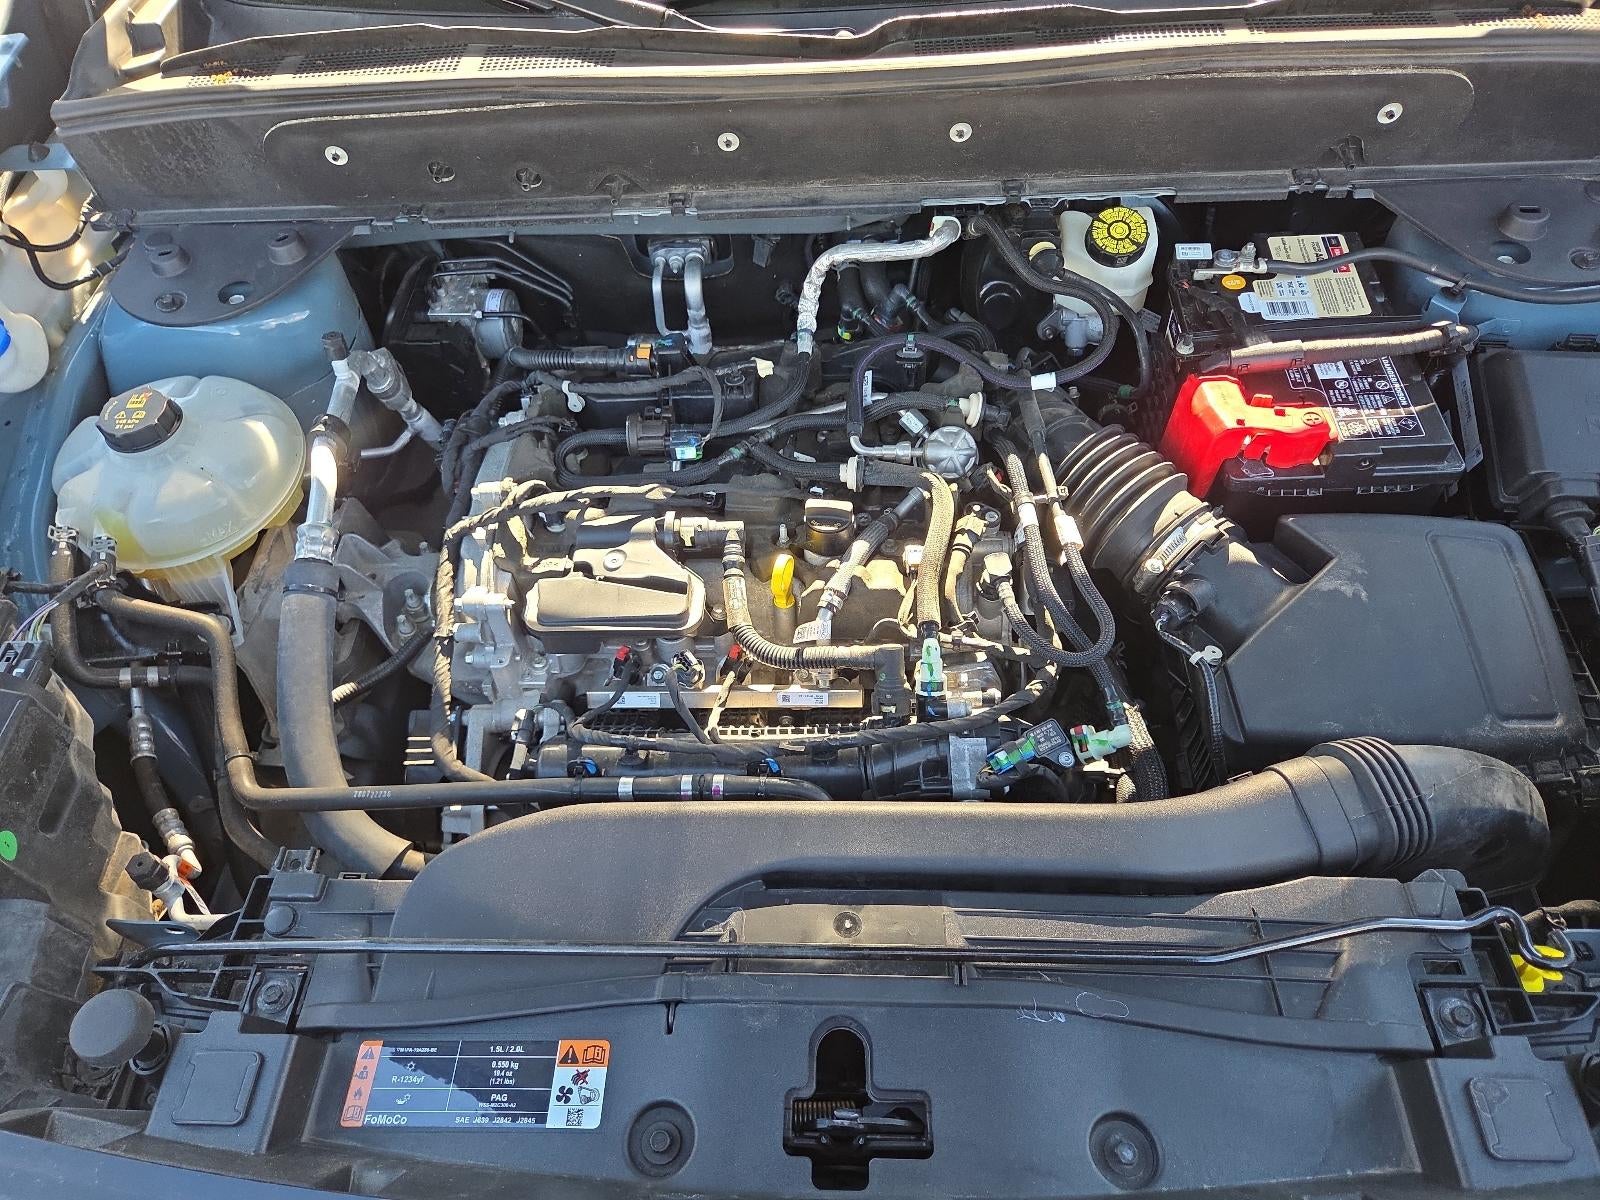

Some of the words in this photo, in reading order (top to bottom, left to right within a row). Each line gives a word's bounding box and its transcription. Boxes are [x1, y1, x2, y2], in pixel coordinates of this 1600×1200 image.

[510, 1061, 519, 1069] kg
[391, 1075, 425, 1085] R-1234yf
[490, 1093, 508, 1101] PAG
[363, 1114, 408, 1125] FoMoCo
[455, 1116, 470, 1124] SAE
[472, 1116, 490, 1124] J639
[492, 1116, 512, 1124] J2842
[516, 1116, 536, 1124] J2845
